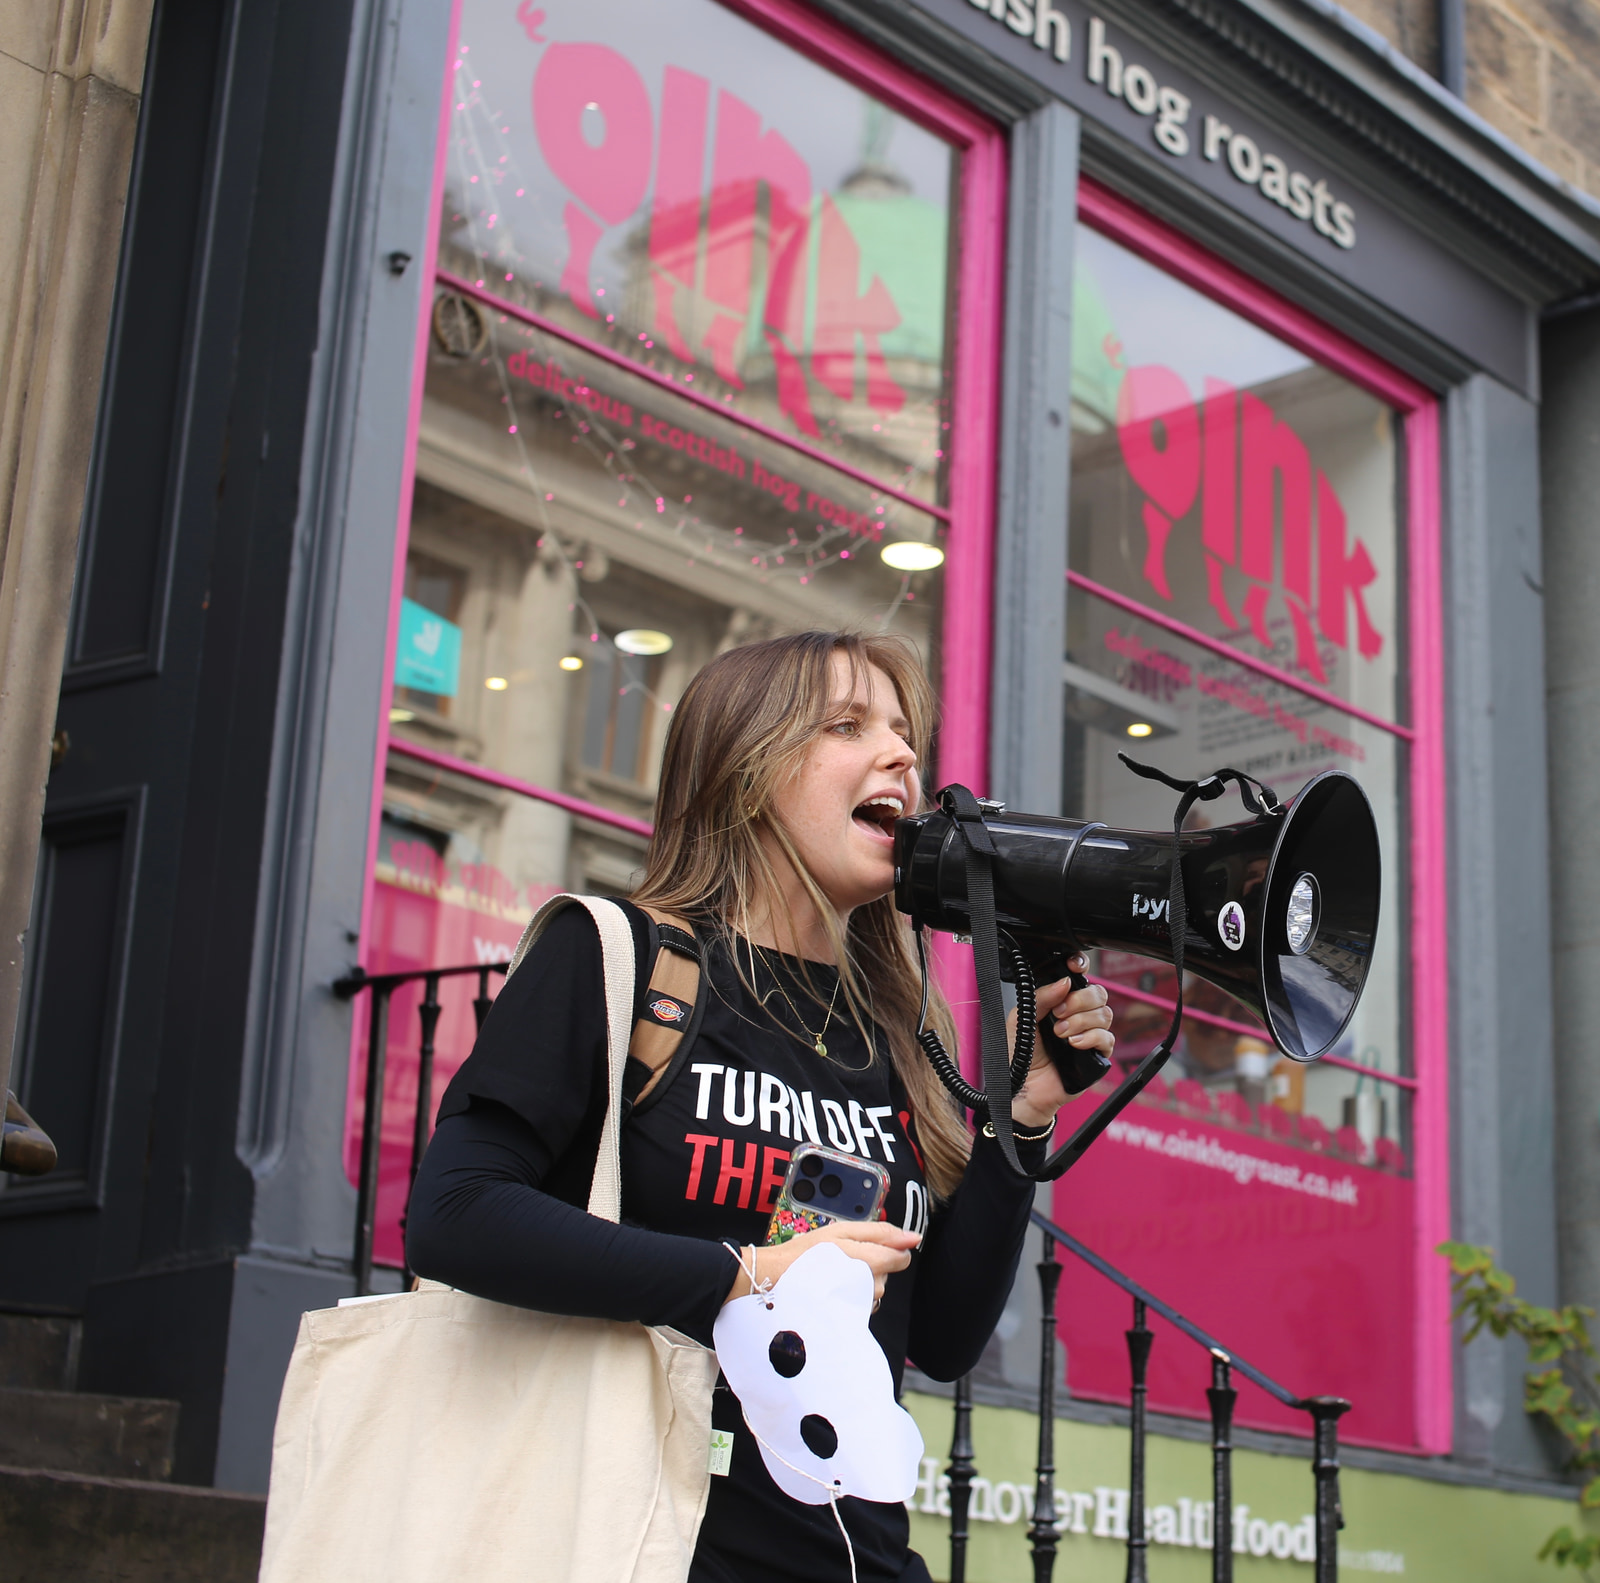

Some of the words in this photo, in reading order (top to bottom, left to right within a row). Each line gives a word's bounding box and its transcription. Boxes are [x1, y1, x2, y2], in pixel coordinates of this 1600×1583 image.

[1087, 16, 1191, 157] hog
[1204, 114, 1356, 249] roasts
[506, 348, 634, 428] delicious
[640, 413, 746, 480] scottish
[752, 458, 802, 513] hog
[684, 1133, 791, 1214] THE
[691, 1063, 824, 1146] TURN
[820, 1099, 897, 1163] OFF
